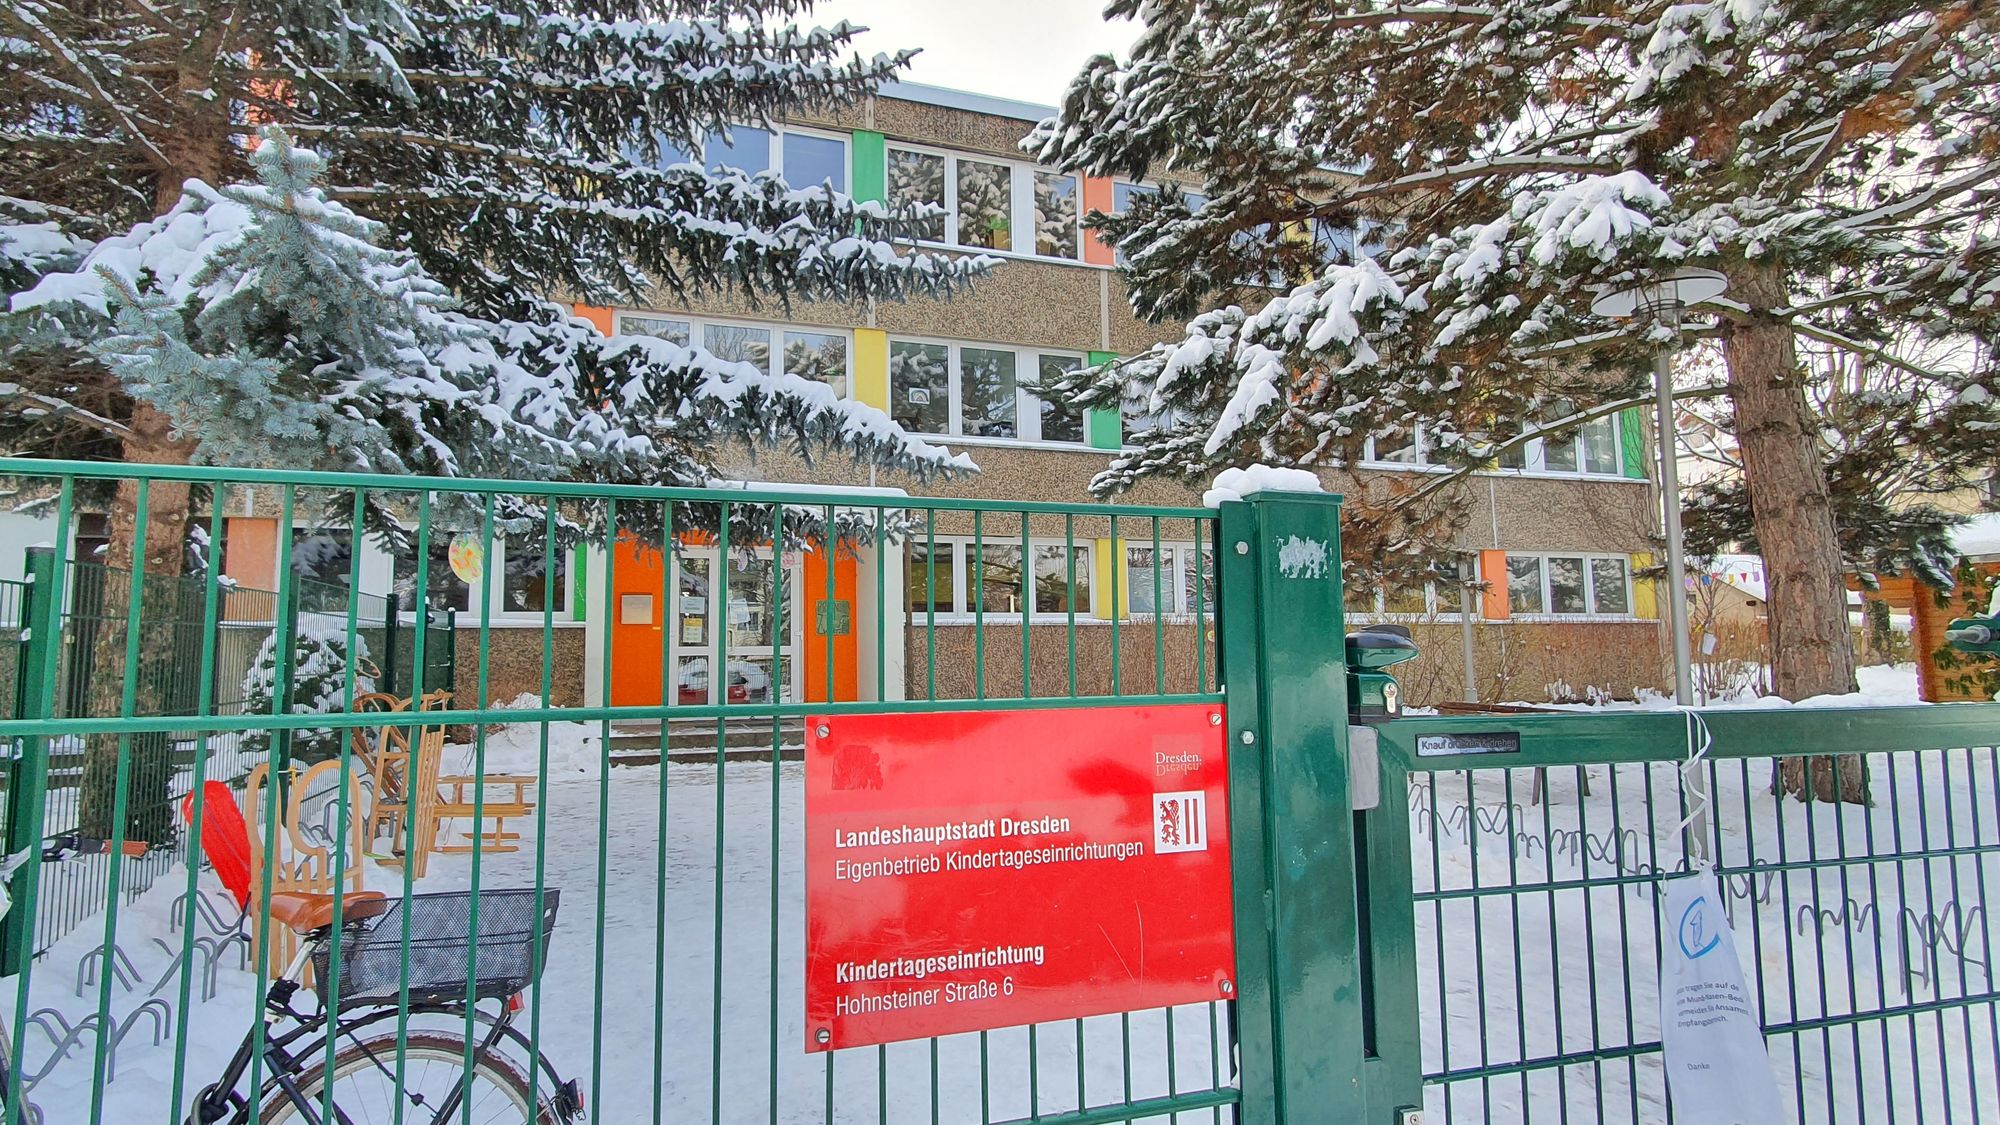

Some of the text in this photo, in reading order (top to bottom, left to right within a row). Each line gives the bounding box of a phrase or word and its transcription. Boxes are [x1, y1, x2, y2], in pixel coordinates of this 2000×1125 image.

[1155, 750, 1202, 764] Dresden.
[1421, 739, 1447, 750] Knauf
[835, 816, 1070, 848] Landeshauptstadt Dresden
[835, 841, 1144, 882] Eigenbetrieb Kindertageseinrichtungen
[836, 945, 1045, 983] Kindertageseinrichtung
[836, 976, 1014, 1016] Hohnsteiner Straße 6
[1687, 1062, 1710, 1071] Danke
